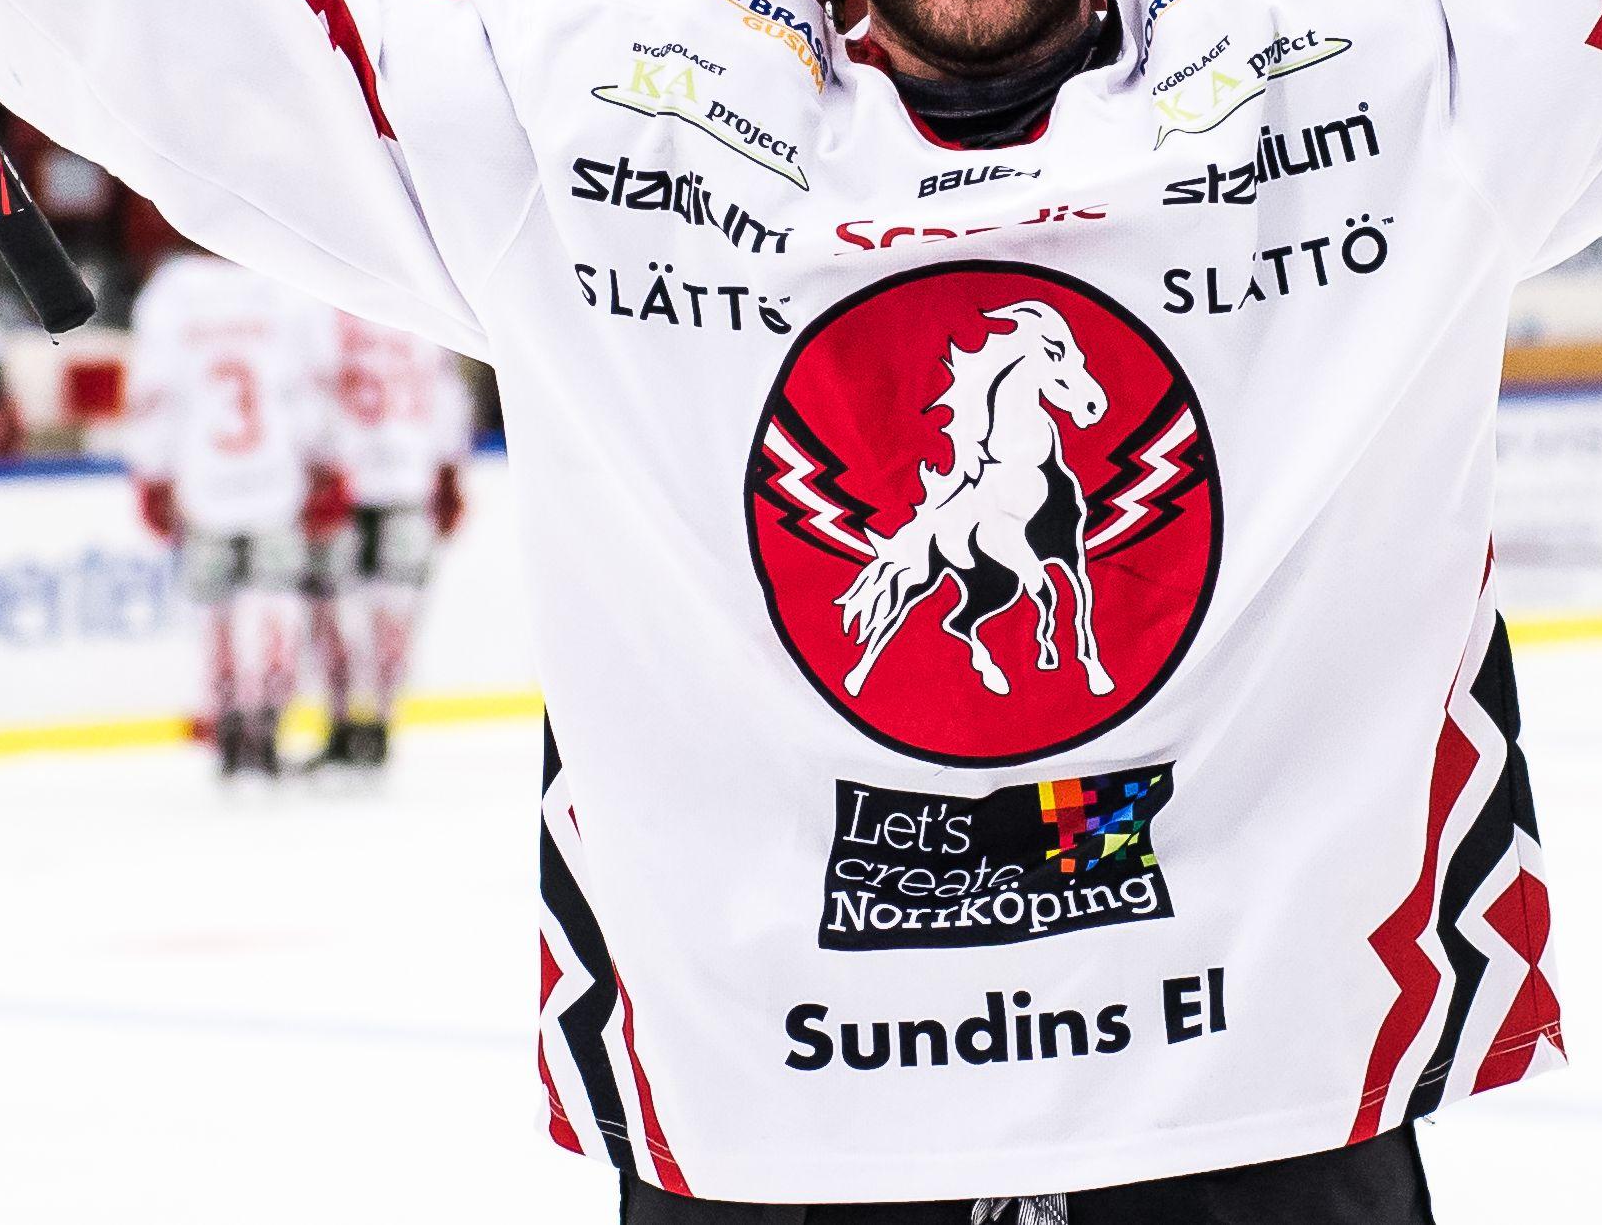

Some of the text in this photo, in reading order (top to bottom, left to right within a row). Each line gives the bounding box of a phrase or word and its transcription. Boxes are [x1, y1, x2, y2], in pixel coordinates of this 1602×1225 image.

[1247, 29, 1318, 78] prject
[626, 58, 798, 163] KA project
[208, 355, 265, 456] 3
[843, 789, 973, 854] Let's
[827, 873, 1160, 933] Norrköping
[835, 855, 1024, 898] create
[784, 966, 1228, 1071] Sundins El
